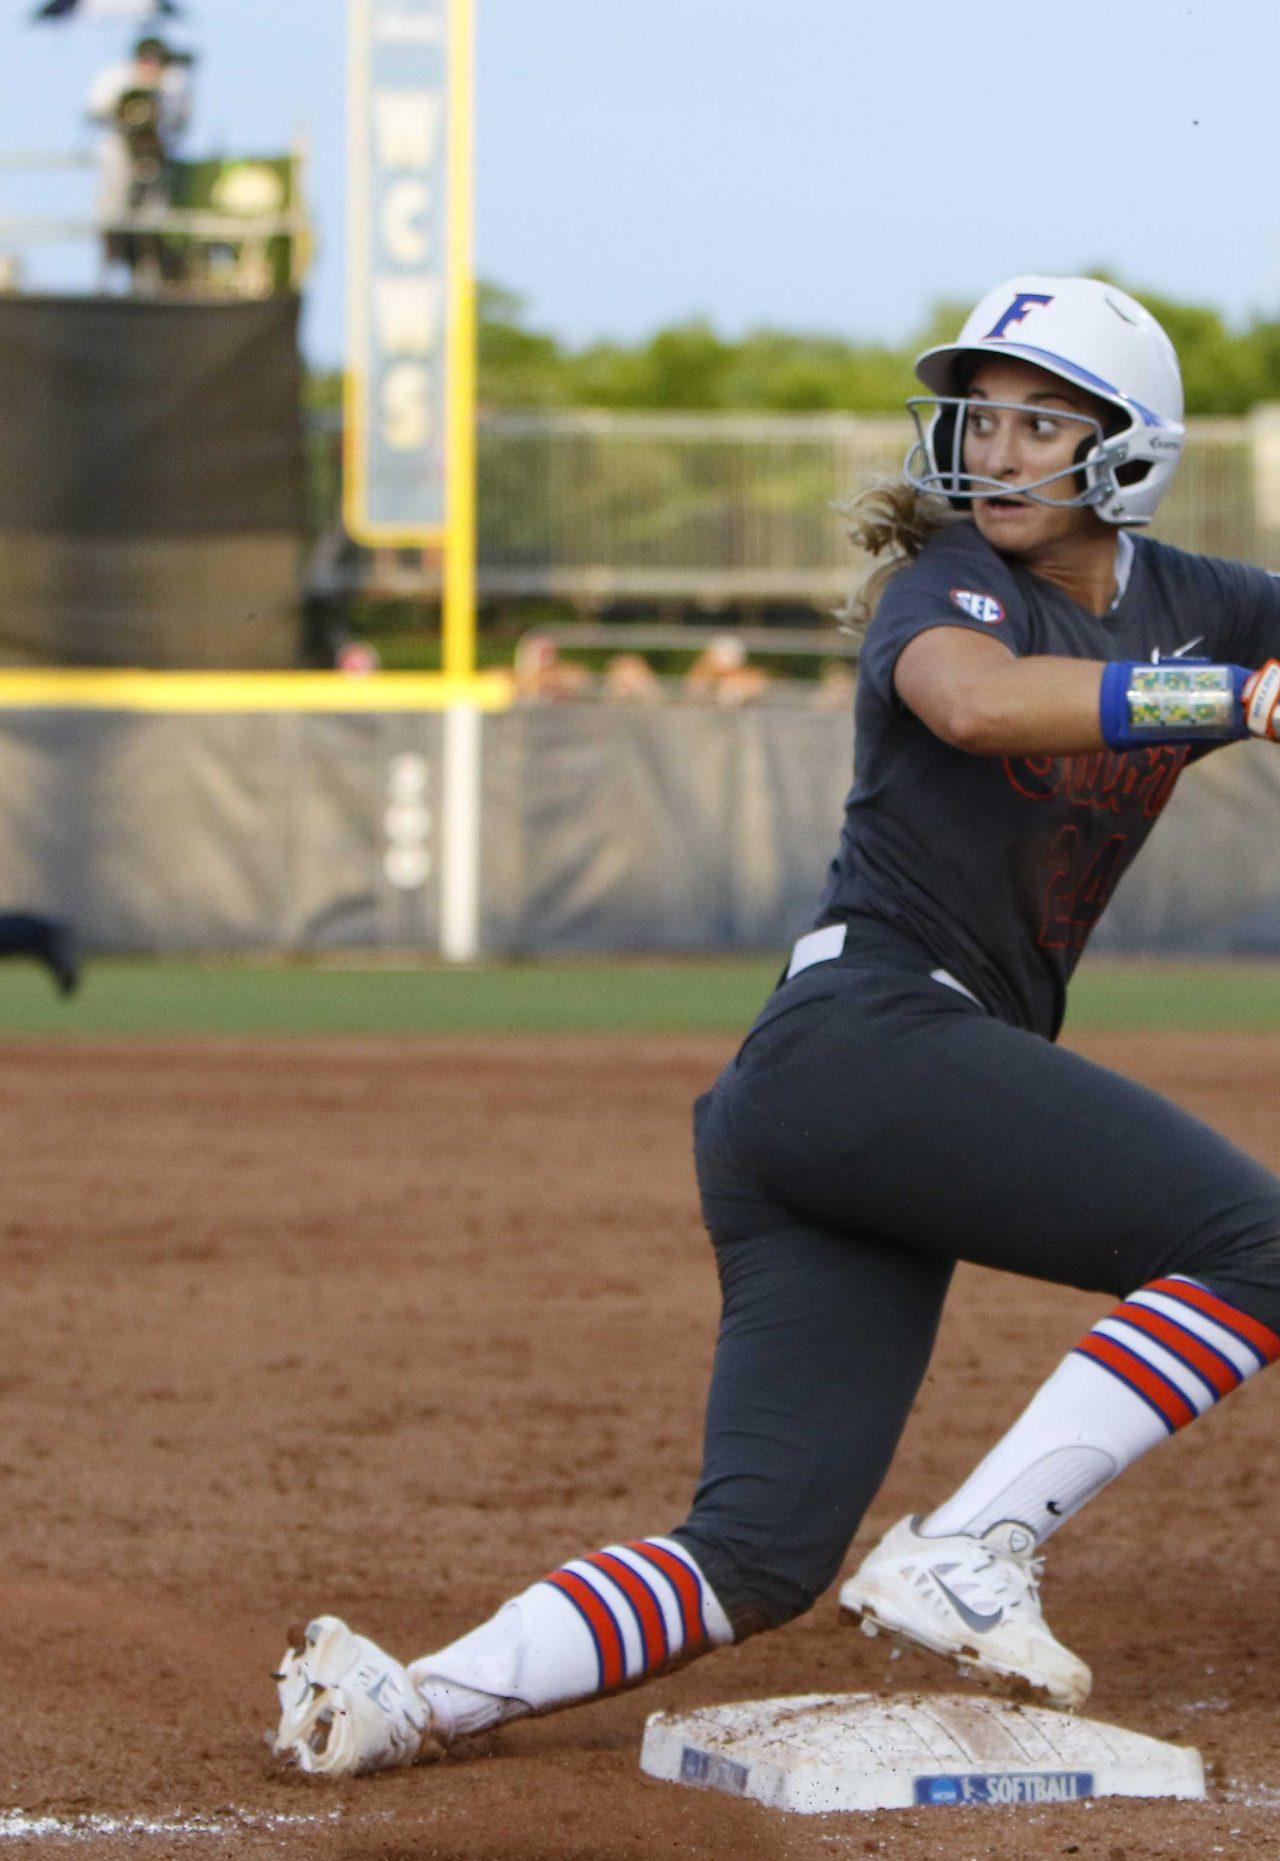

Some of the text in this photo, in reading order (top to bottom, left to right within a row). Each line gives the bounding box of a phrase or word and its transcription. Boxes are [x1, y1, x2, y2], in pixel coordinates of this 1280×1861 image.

[979, 292, 1055, 340] F
[953, 591, 1001, 622] SEC
[985, 1775, 1078, 1804] SOFTBALL
